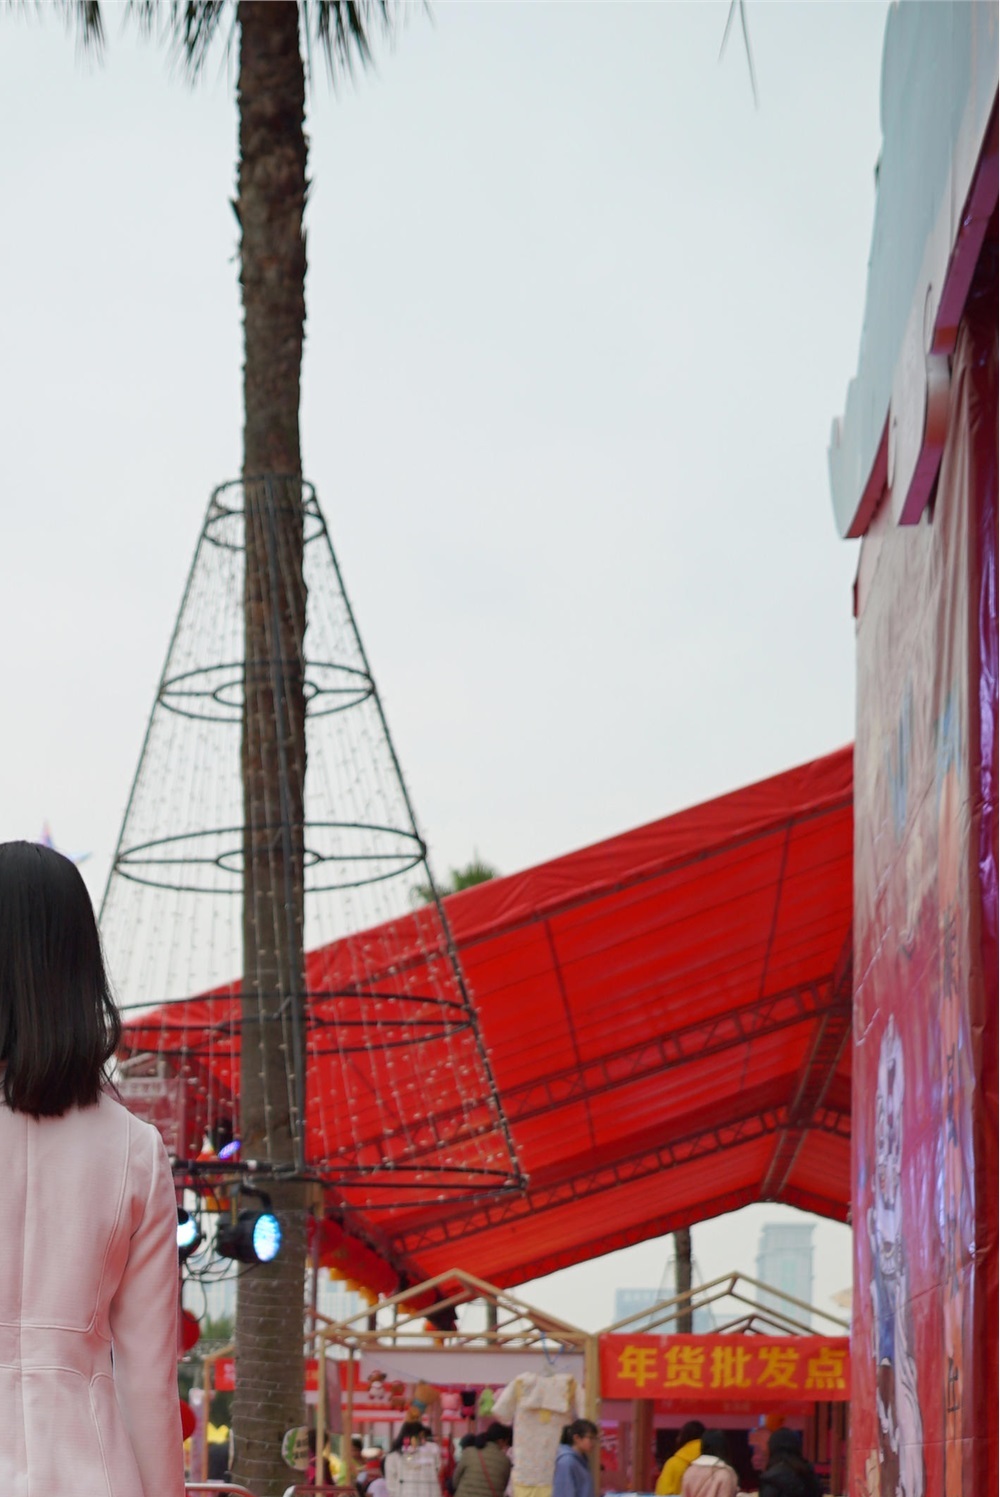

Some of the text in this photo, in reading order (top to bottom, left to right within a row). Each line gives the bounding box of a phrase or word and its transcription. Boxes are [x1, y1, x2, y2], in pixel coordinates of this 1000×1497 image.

[617, 1345, 846, 1389] 年货批发点
